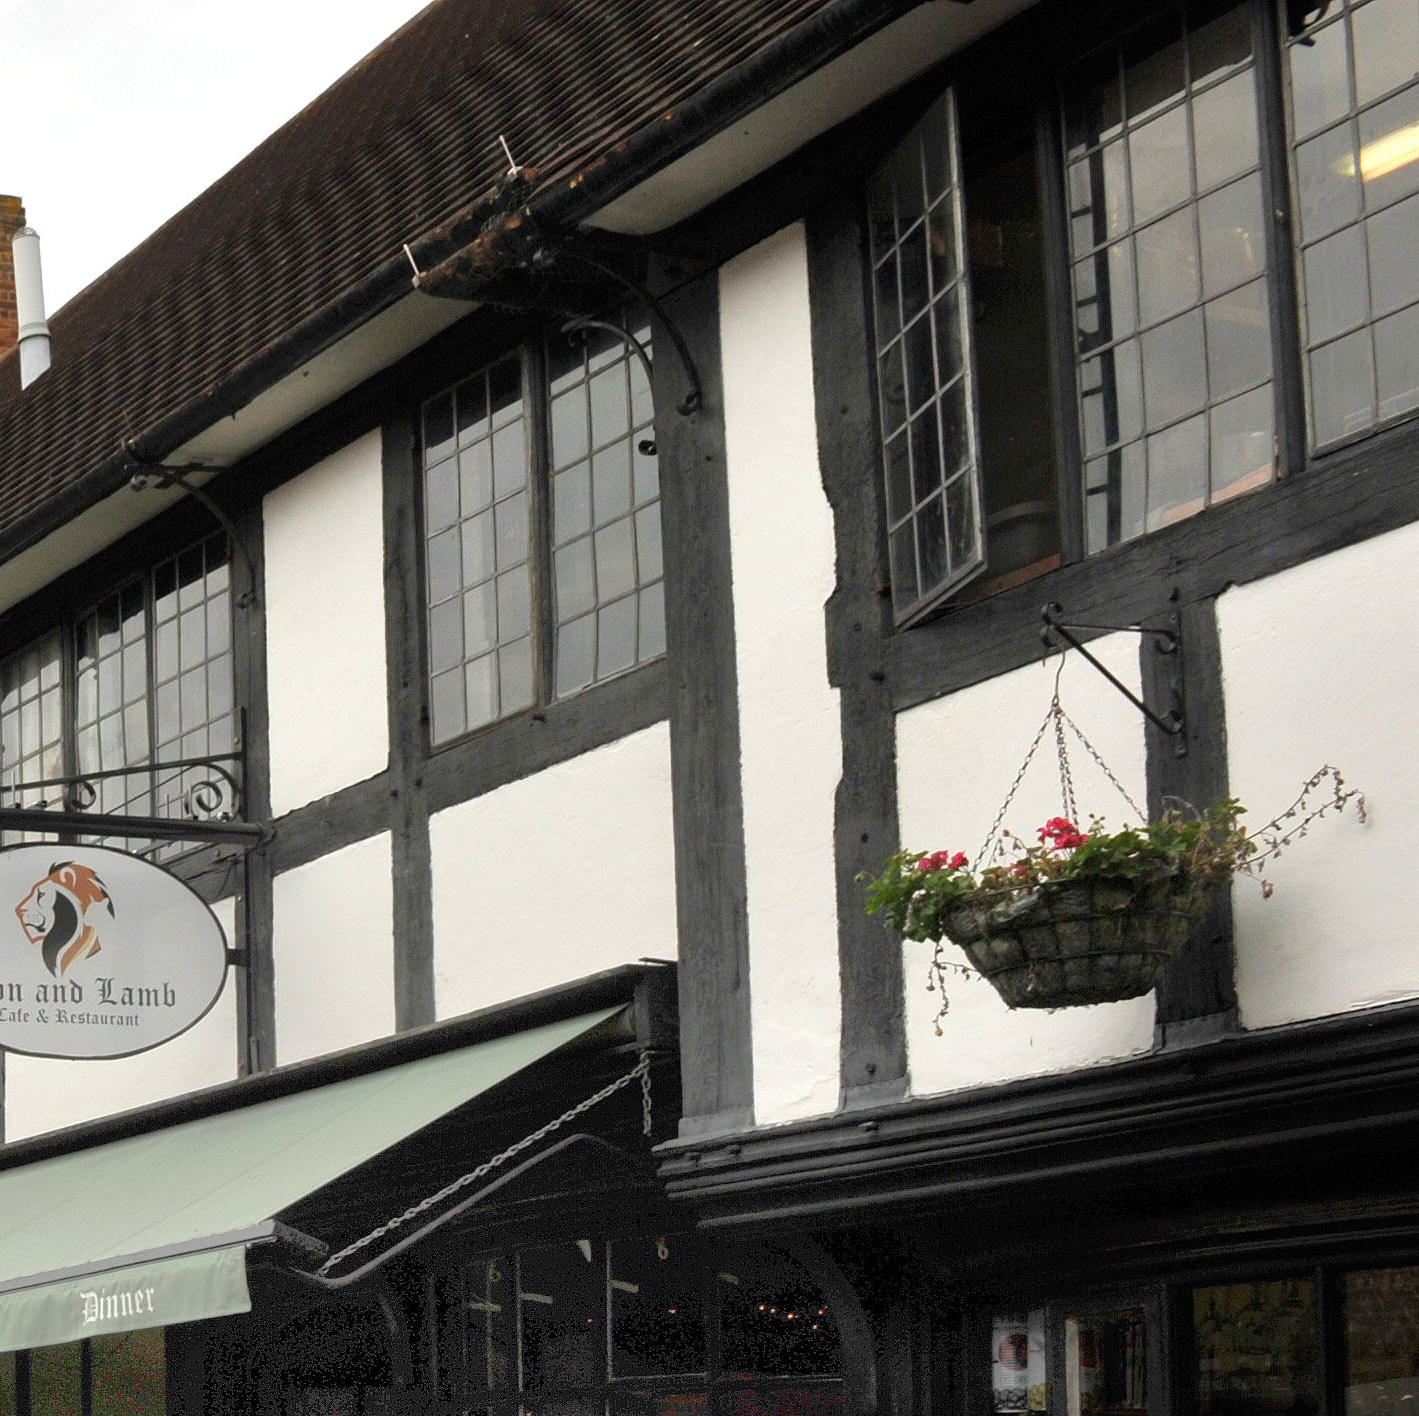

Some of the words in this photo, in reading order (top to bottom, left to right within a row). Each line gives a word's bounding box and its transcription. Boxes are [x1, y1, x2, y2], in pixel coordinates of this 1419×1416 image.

[35, 979, 83, 1004] and
[95, 977, 176, 1008] Lamb
[36, 1008, 50, 1024] &
[56, 1008, 140, 1027] Restaurant
[80, 1287, 154, 1326] Dinner
